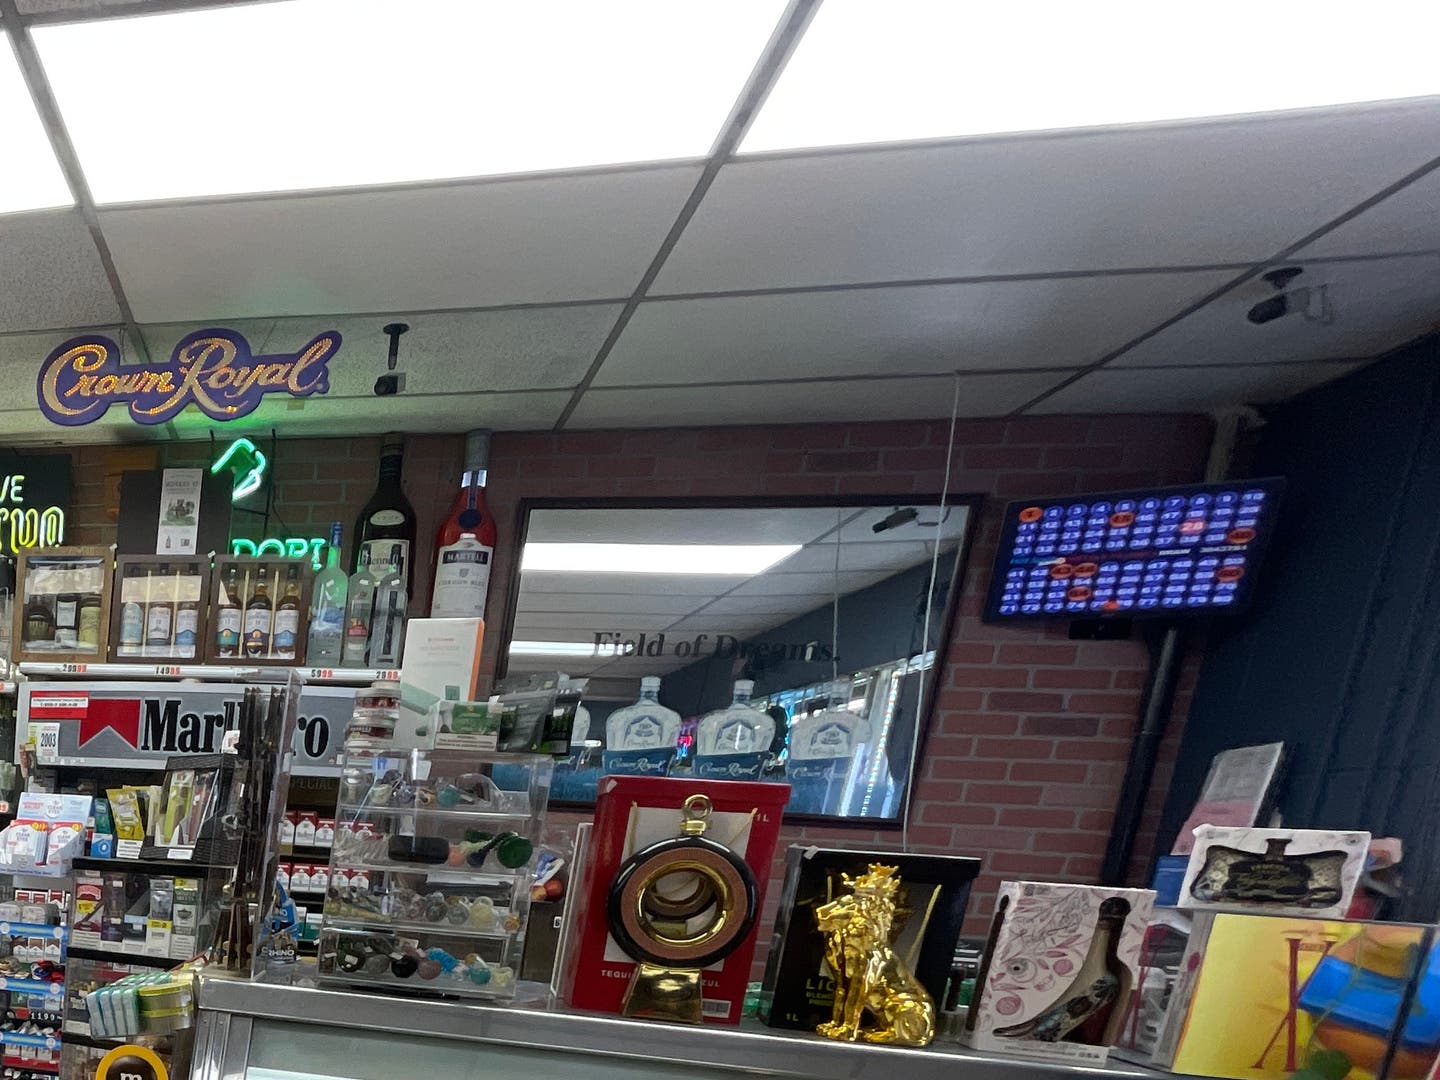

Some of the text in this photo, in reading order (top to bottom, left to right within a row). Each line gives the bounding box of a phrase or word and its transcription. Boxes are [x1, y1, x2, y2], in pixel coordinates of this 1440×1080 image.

[42, 336, 332, 416] Crown Royal
[593, 631, 708, 657] Field of
[40, 732, 57, 748] 2003
[141, 699, 330, 760] Marlro
